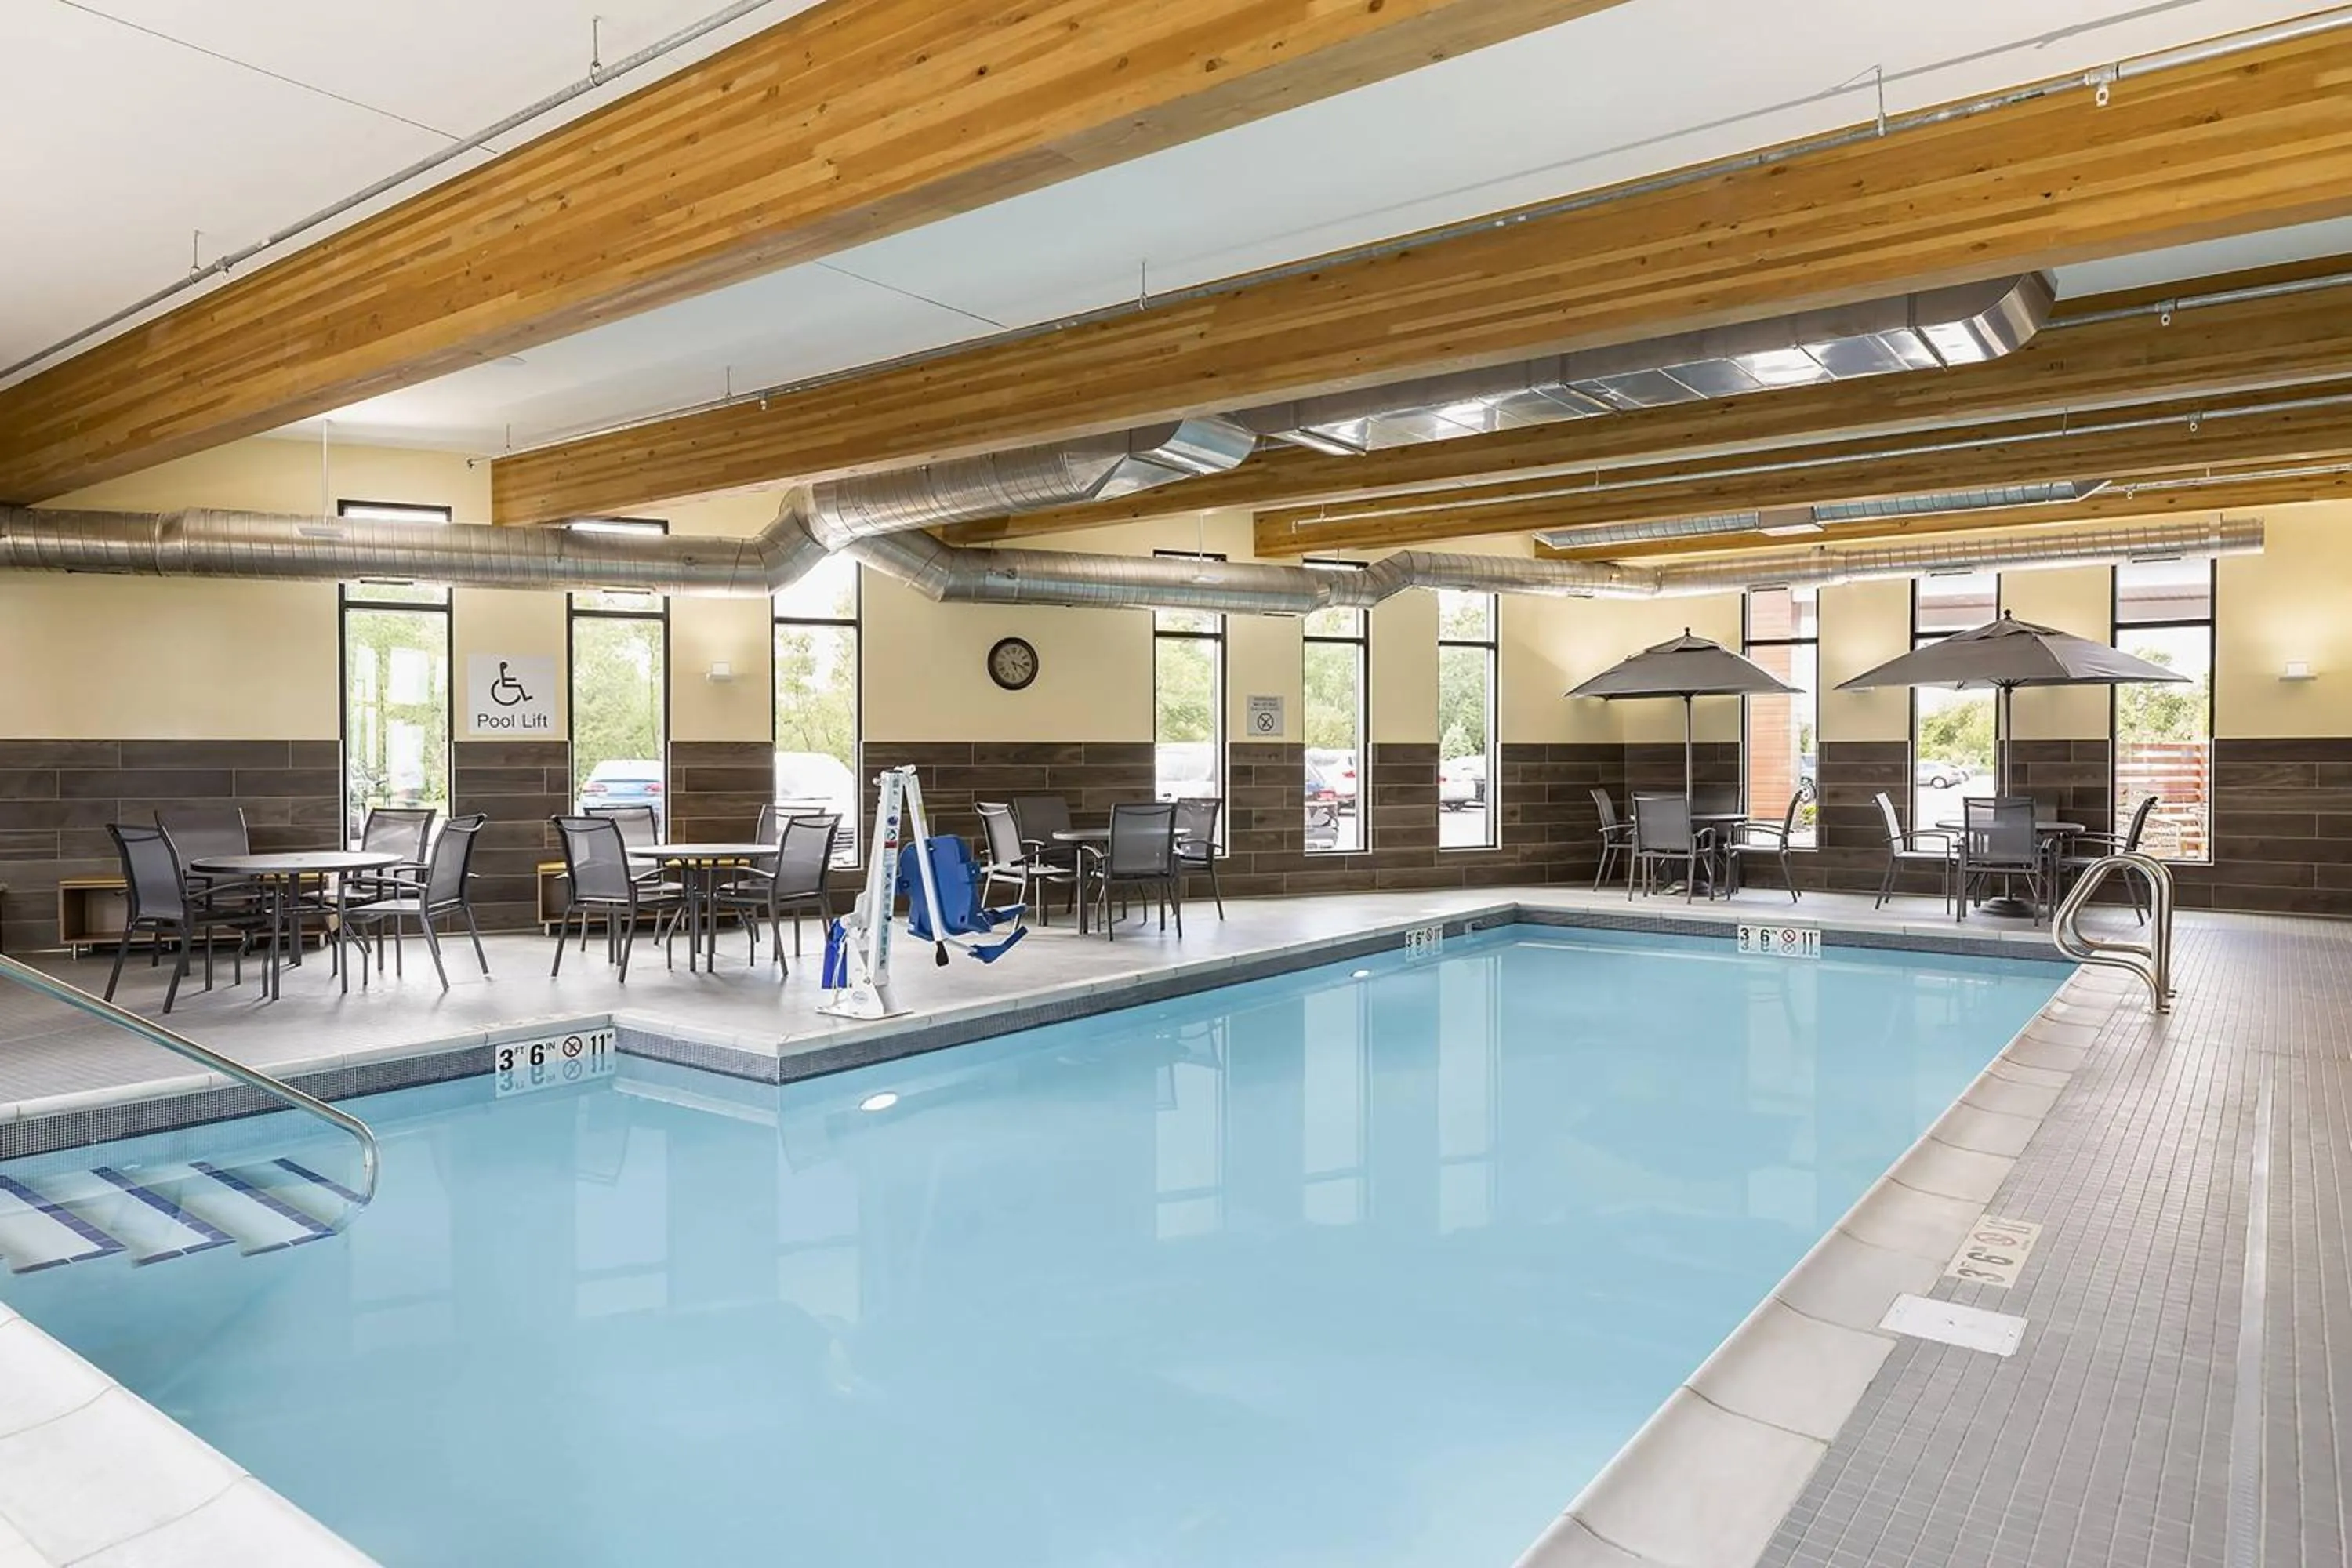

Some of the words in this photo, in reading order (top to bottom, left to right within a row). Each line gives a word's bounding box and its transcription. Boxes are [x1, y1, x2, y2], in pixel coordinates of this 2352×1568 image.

[477, 713, 516, 728] Pool
[522, 713, 548, 728] Lift
[1740, 927, 1750, 941] 3
[1760, 929, 1770, 942] 6
[499, 1048, 514, 1072] 3
[515, 1047, 525, 1055] FT
[530, 1044, 545, 1065] 6
[546, 1041, 556, 1051] IN
[1967, 1252, 2014, 1265] 6
[1957, 1269, 2005, 1282] 3
